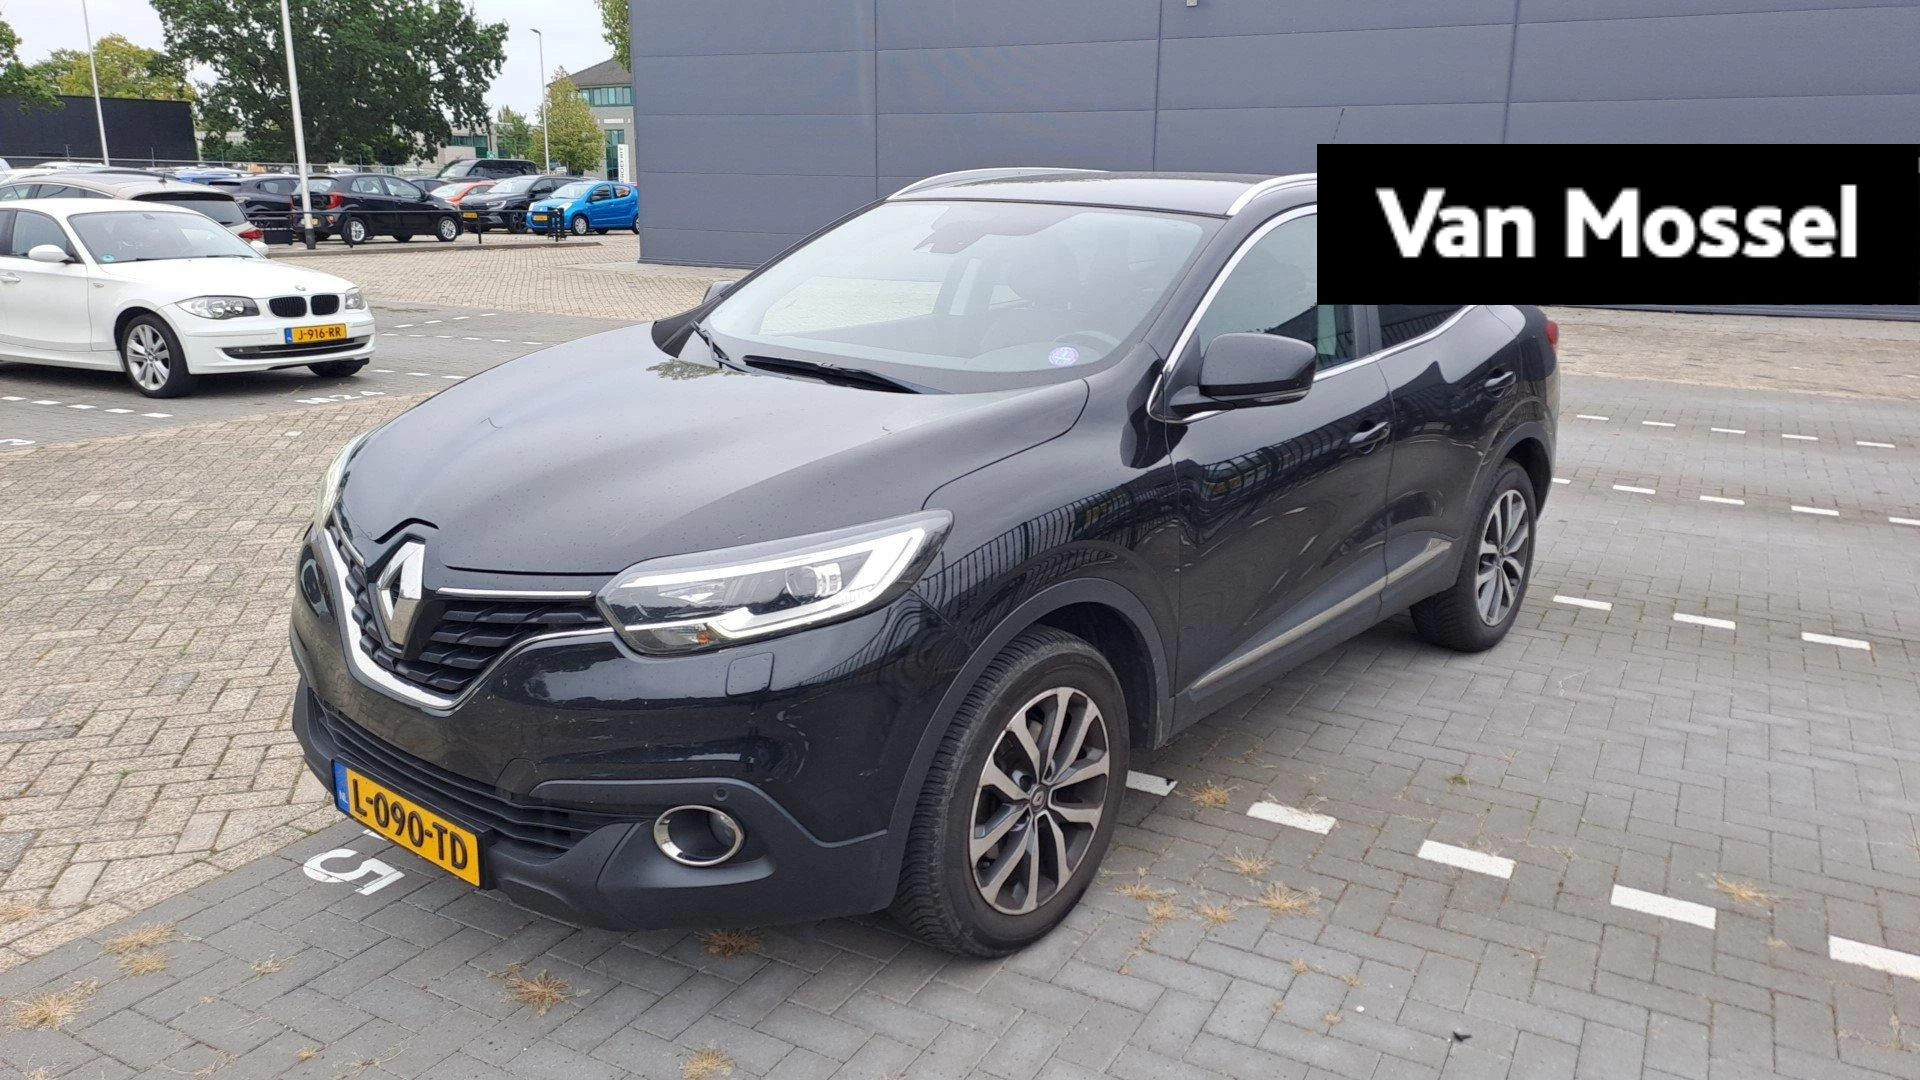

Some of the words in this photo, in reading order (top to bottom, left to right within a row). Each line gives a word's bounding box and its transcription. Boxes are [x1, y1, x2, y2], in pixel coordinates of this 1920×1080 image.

[298, 326, 341, 341] J-916-RR
[352, 778, 468, 870] L-090-TD
[303, 829, 405, 896] 5
